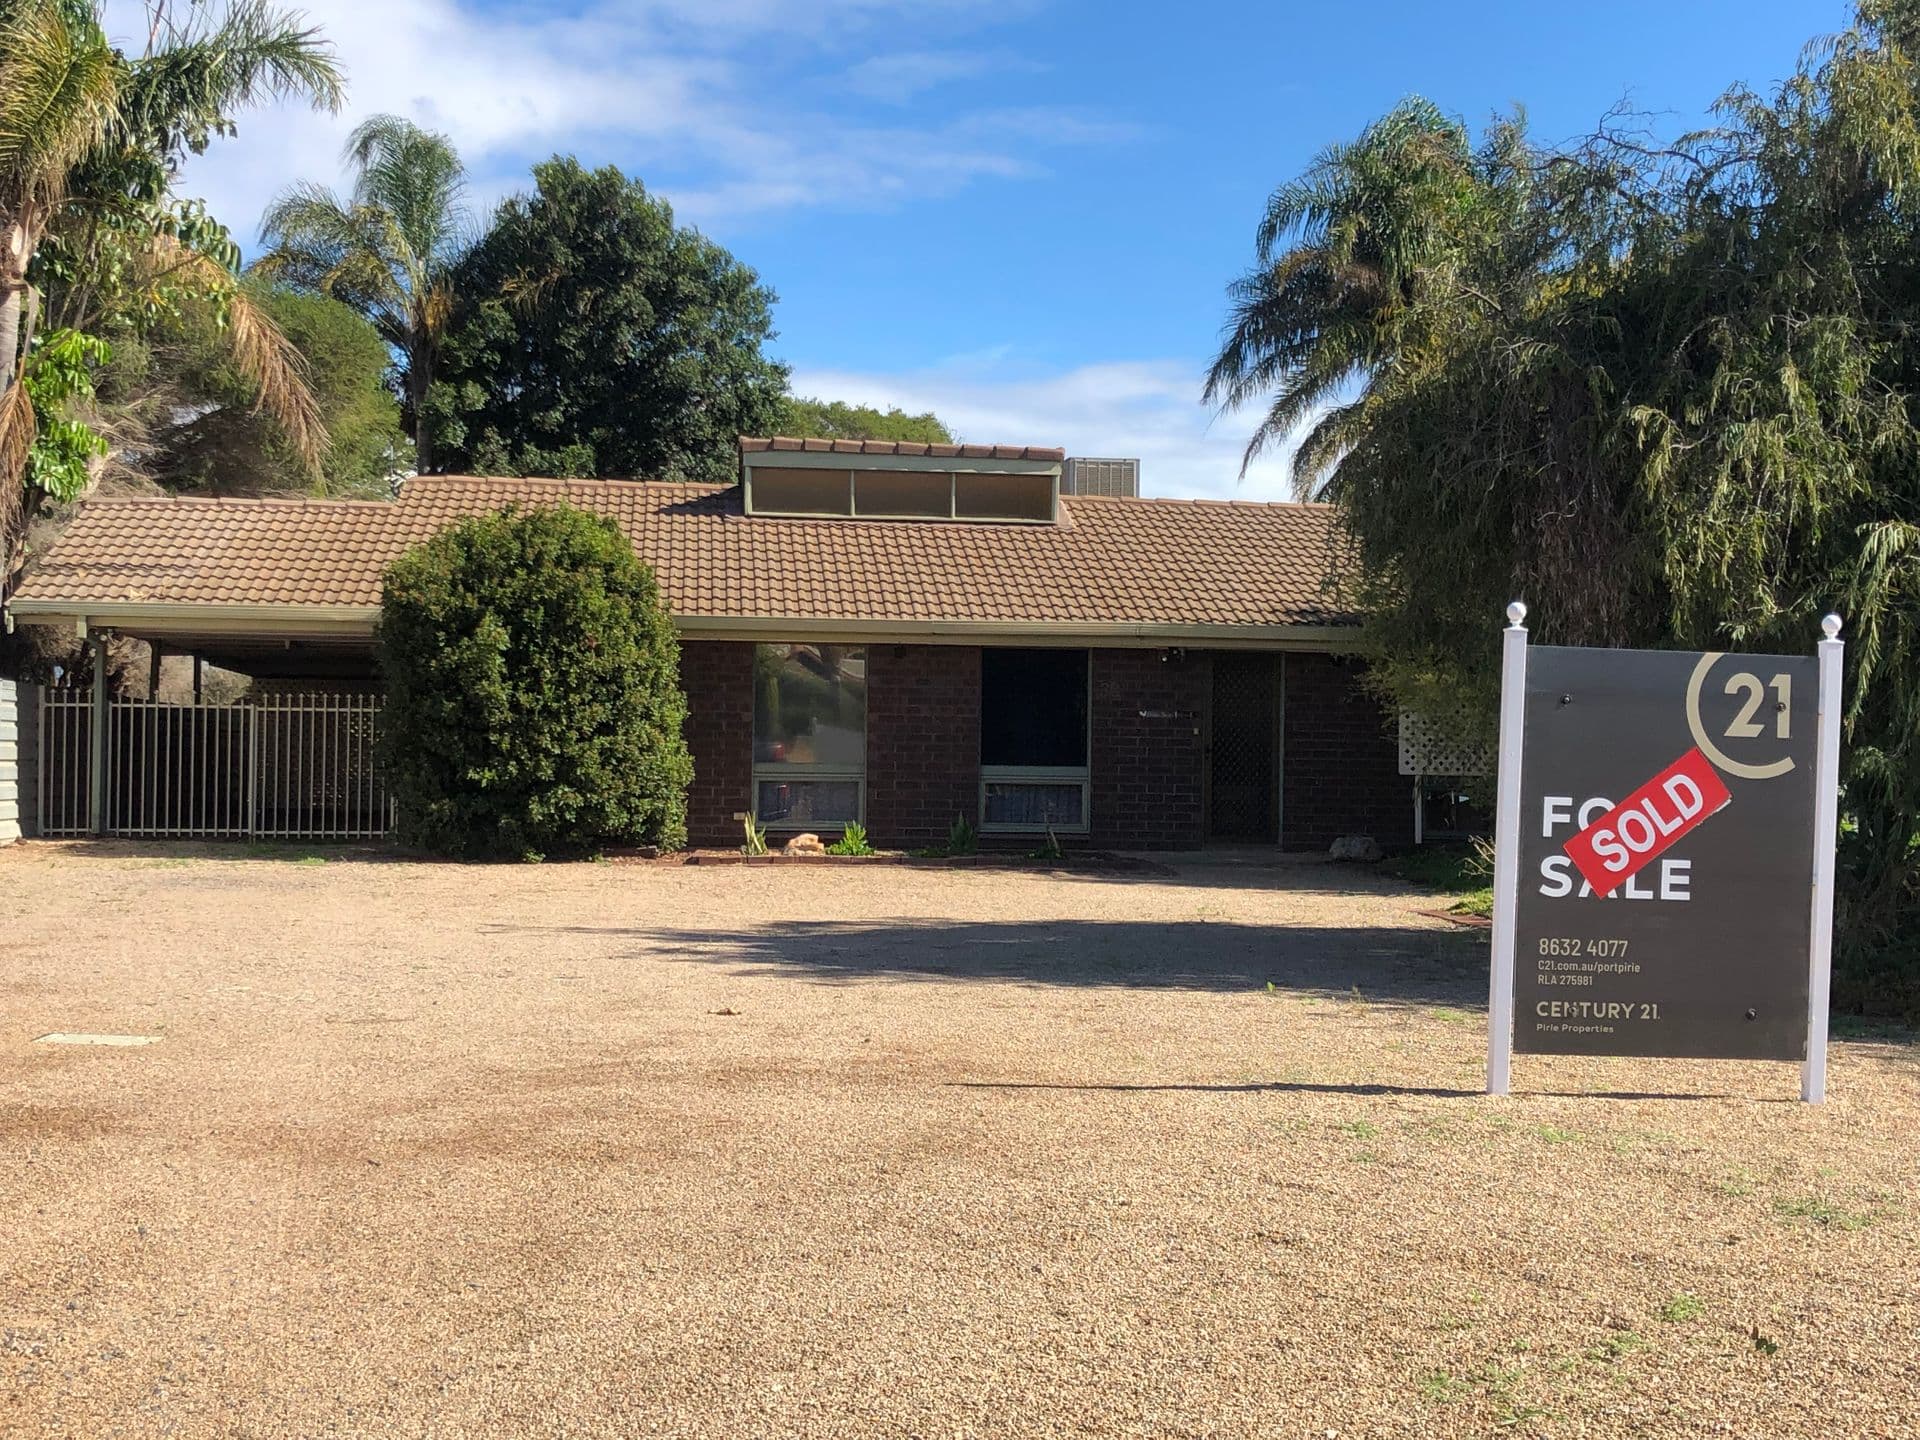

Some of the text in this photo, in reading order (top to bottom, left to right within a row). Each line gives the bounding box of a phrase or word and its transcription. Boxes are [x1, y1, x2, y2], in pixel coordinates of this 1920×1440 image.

[1724, 672, 1792, 739] 21
[1542, 796, 1617, 838] FO
[1591, 774, 1704, 873] SOLD
[1539, 855, 1692, 901] SLE
[1539, 937, 1629, 958] 8632 4077
[1537, 960, 1641, 975] C21.com.au/portpirie
[1537, 974, 1593, 986] RLA 275981
[1536, 1001, 1636, 1019] CENTURY
[1536, 1023, 1614, 1034] Pirie Properties
